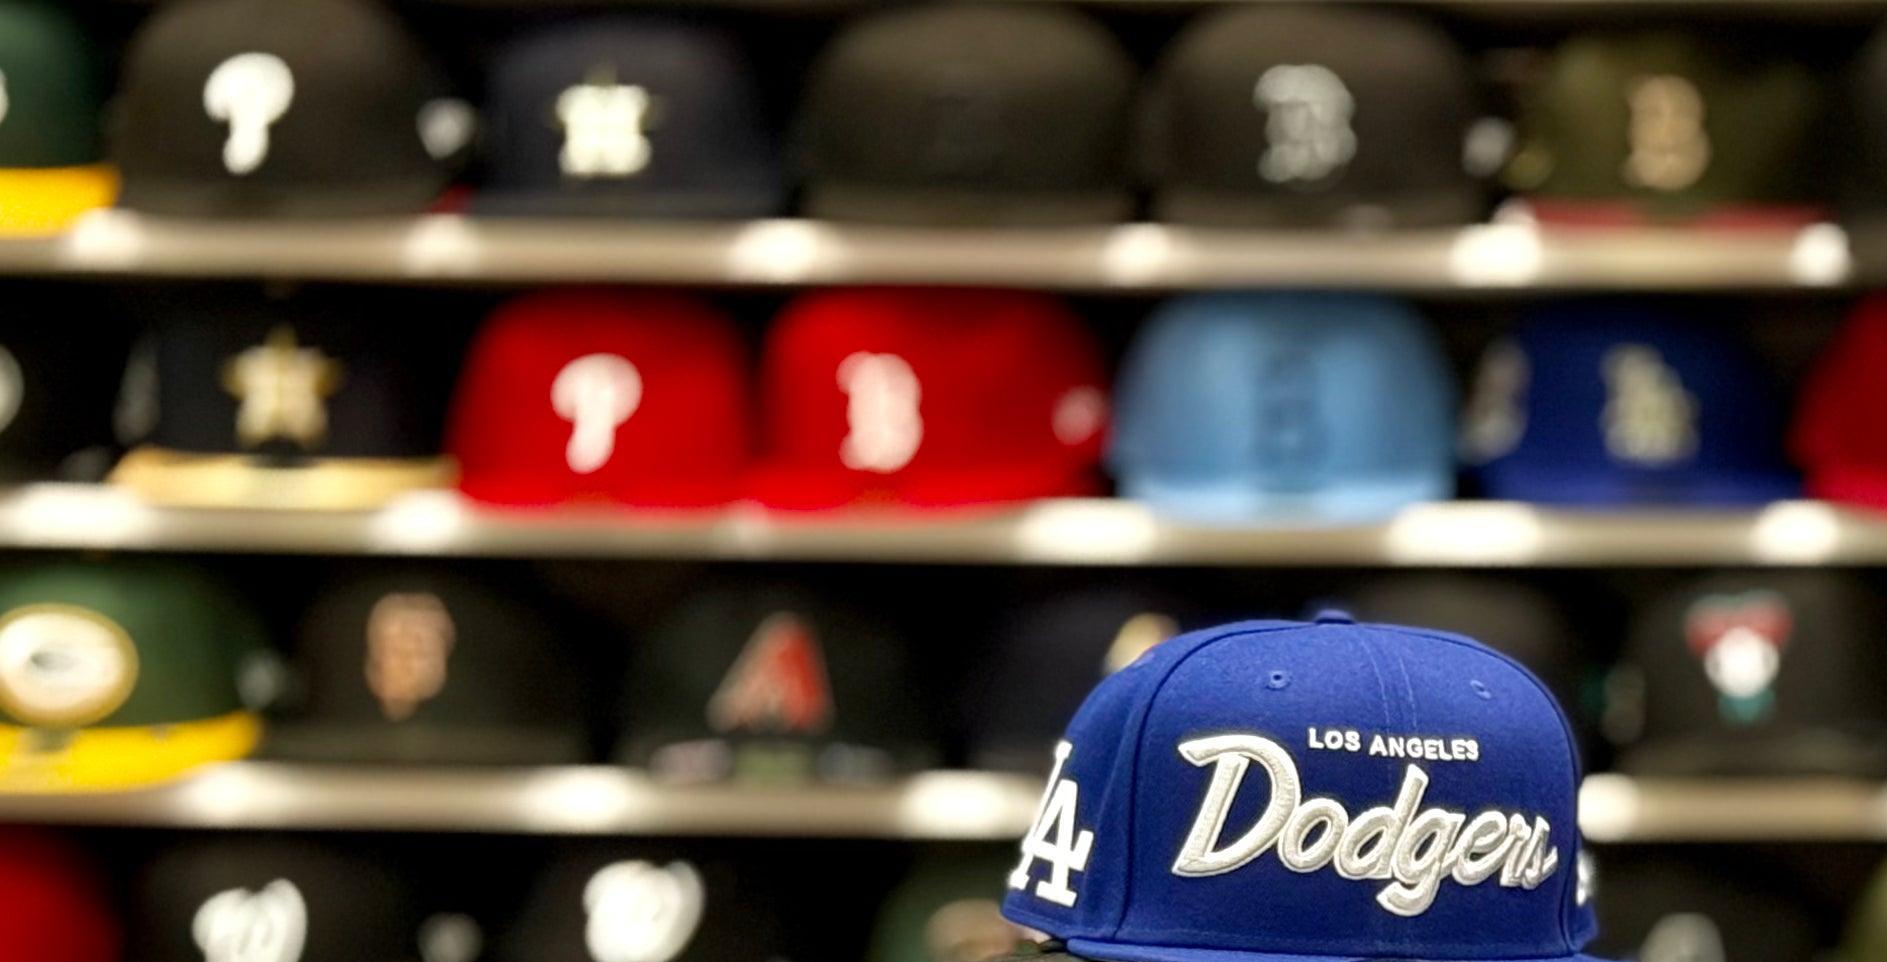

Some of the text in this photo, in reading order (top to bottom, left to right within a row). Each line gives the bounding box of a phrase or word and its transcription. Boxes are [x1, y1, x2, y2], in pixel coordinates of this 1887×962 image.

[1309, 726, 1480, 763] LOS ANGELES
[1172, 733, 1559, 917] Dodgers
